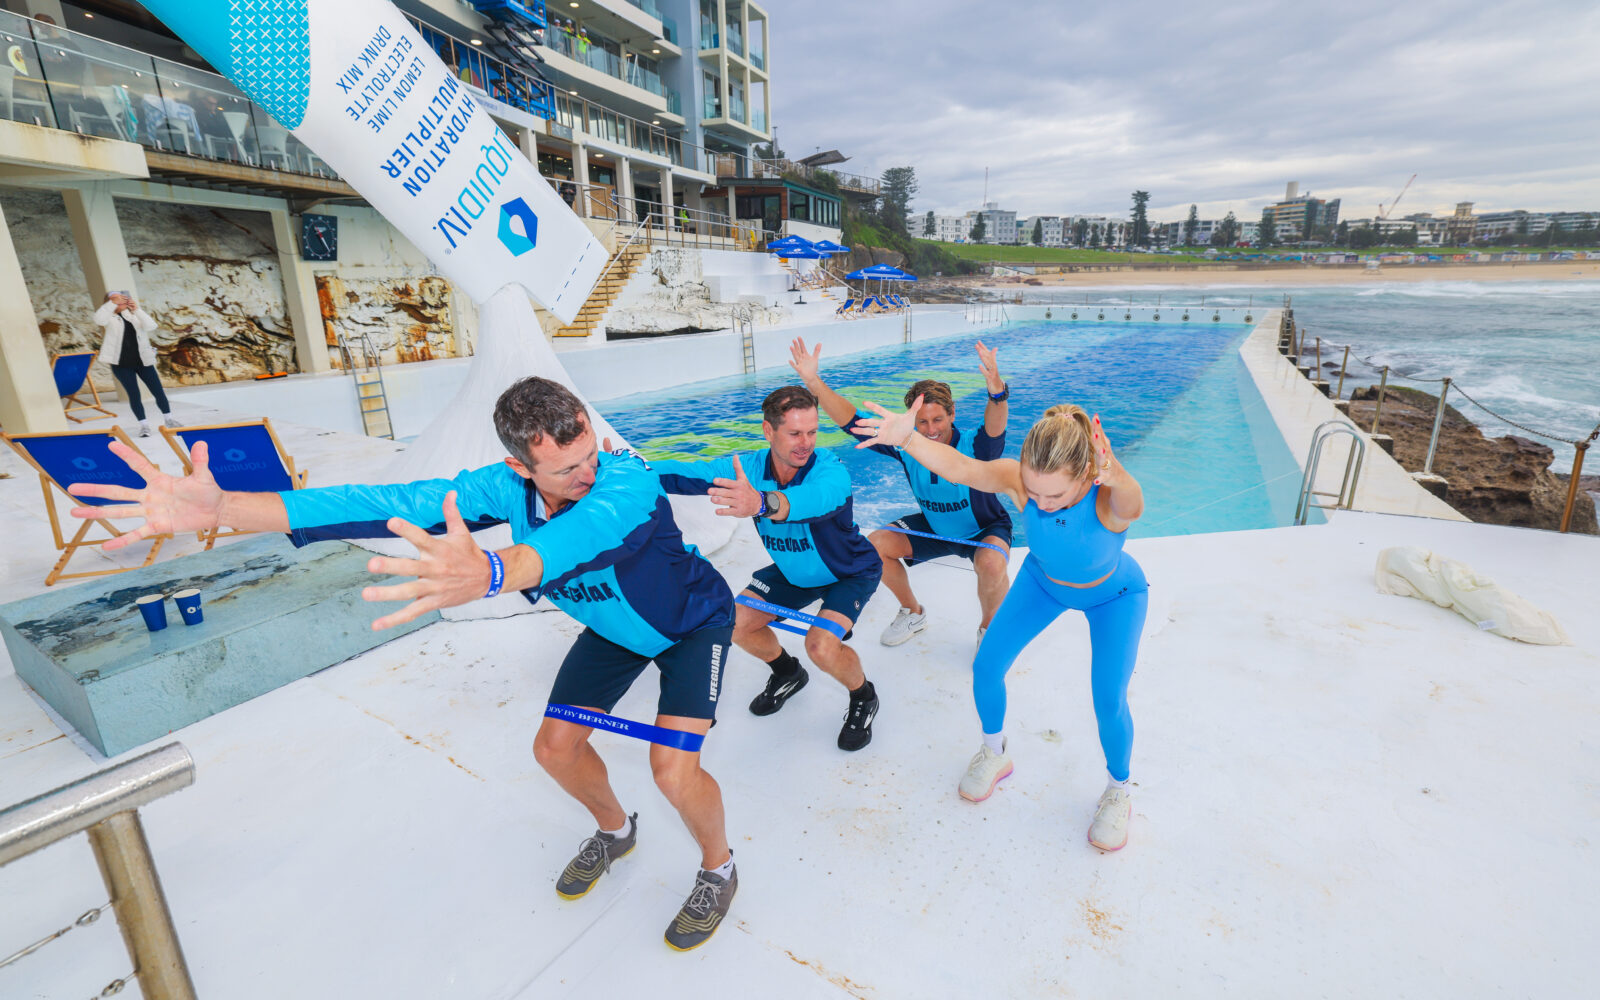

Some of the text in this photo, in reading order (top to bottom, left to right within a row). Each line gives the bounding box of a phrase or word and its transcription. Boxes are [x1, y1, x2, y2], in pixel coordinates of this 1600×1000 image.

[335, 25, 392, 95] DRINK MIX
[346, 35, 412, 121] ELECTROLYTE
[367, 56, 425, 133] LEMON LIME
[380, 72, 460, 179] MULTIPLIER
[402, 94, 476, 197] HYDRATION
[709, 644, 723, 702] LIFEGUARD
[563, 709, 578, 718] BY
[578, 713, 629, 730] BERNER
